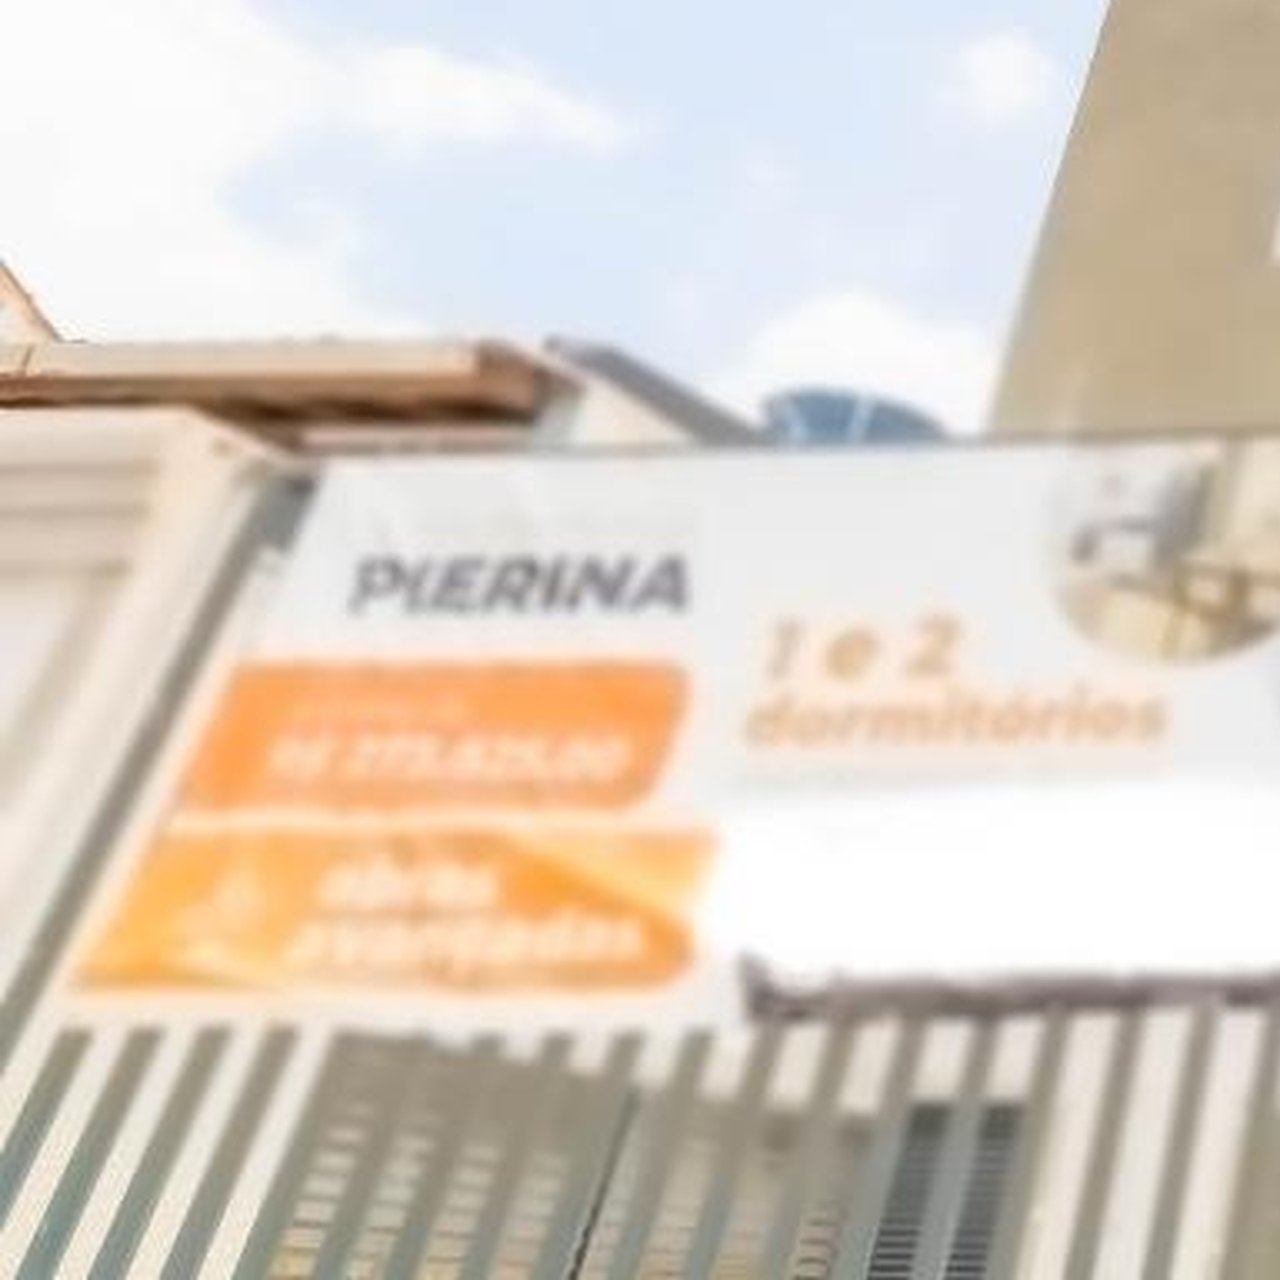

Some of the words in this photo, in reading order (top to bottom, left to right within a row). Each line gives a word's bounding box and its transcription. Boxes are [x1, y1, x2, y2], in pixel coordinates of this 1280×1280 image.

[347, 552, 691, 614] PIERINA
[768, 617, 803, 680] 1
[823, 628, 881, 680] e
[904, 614, 963, 678] 2
